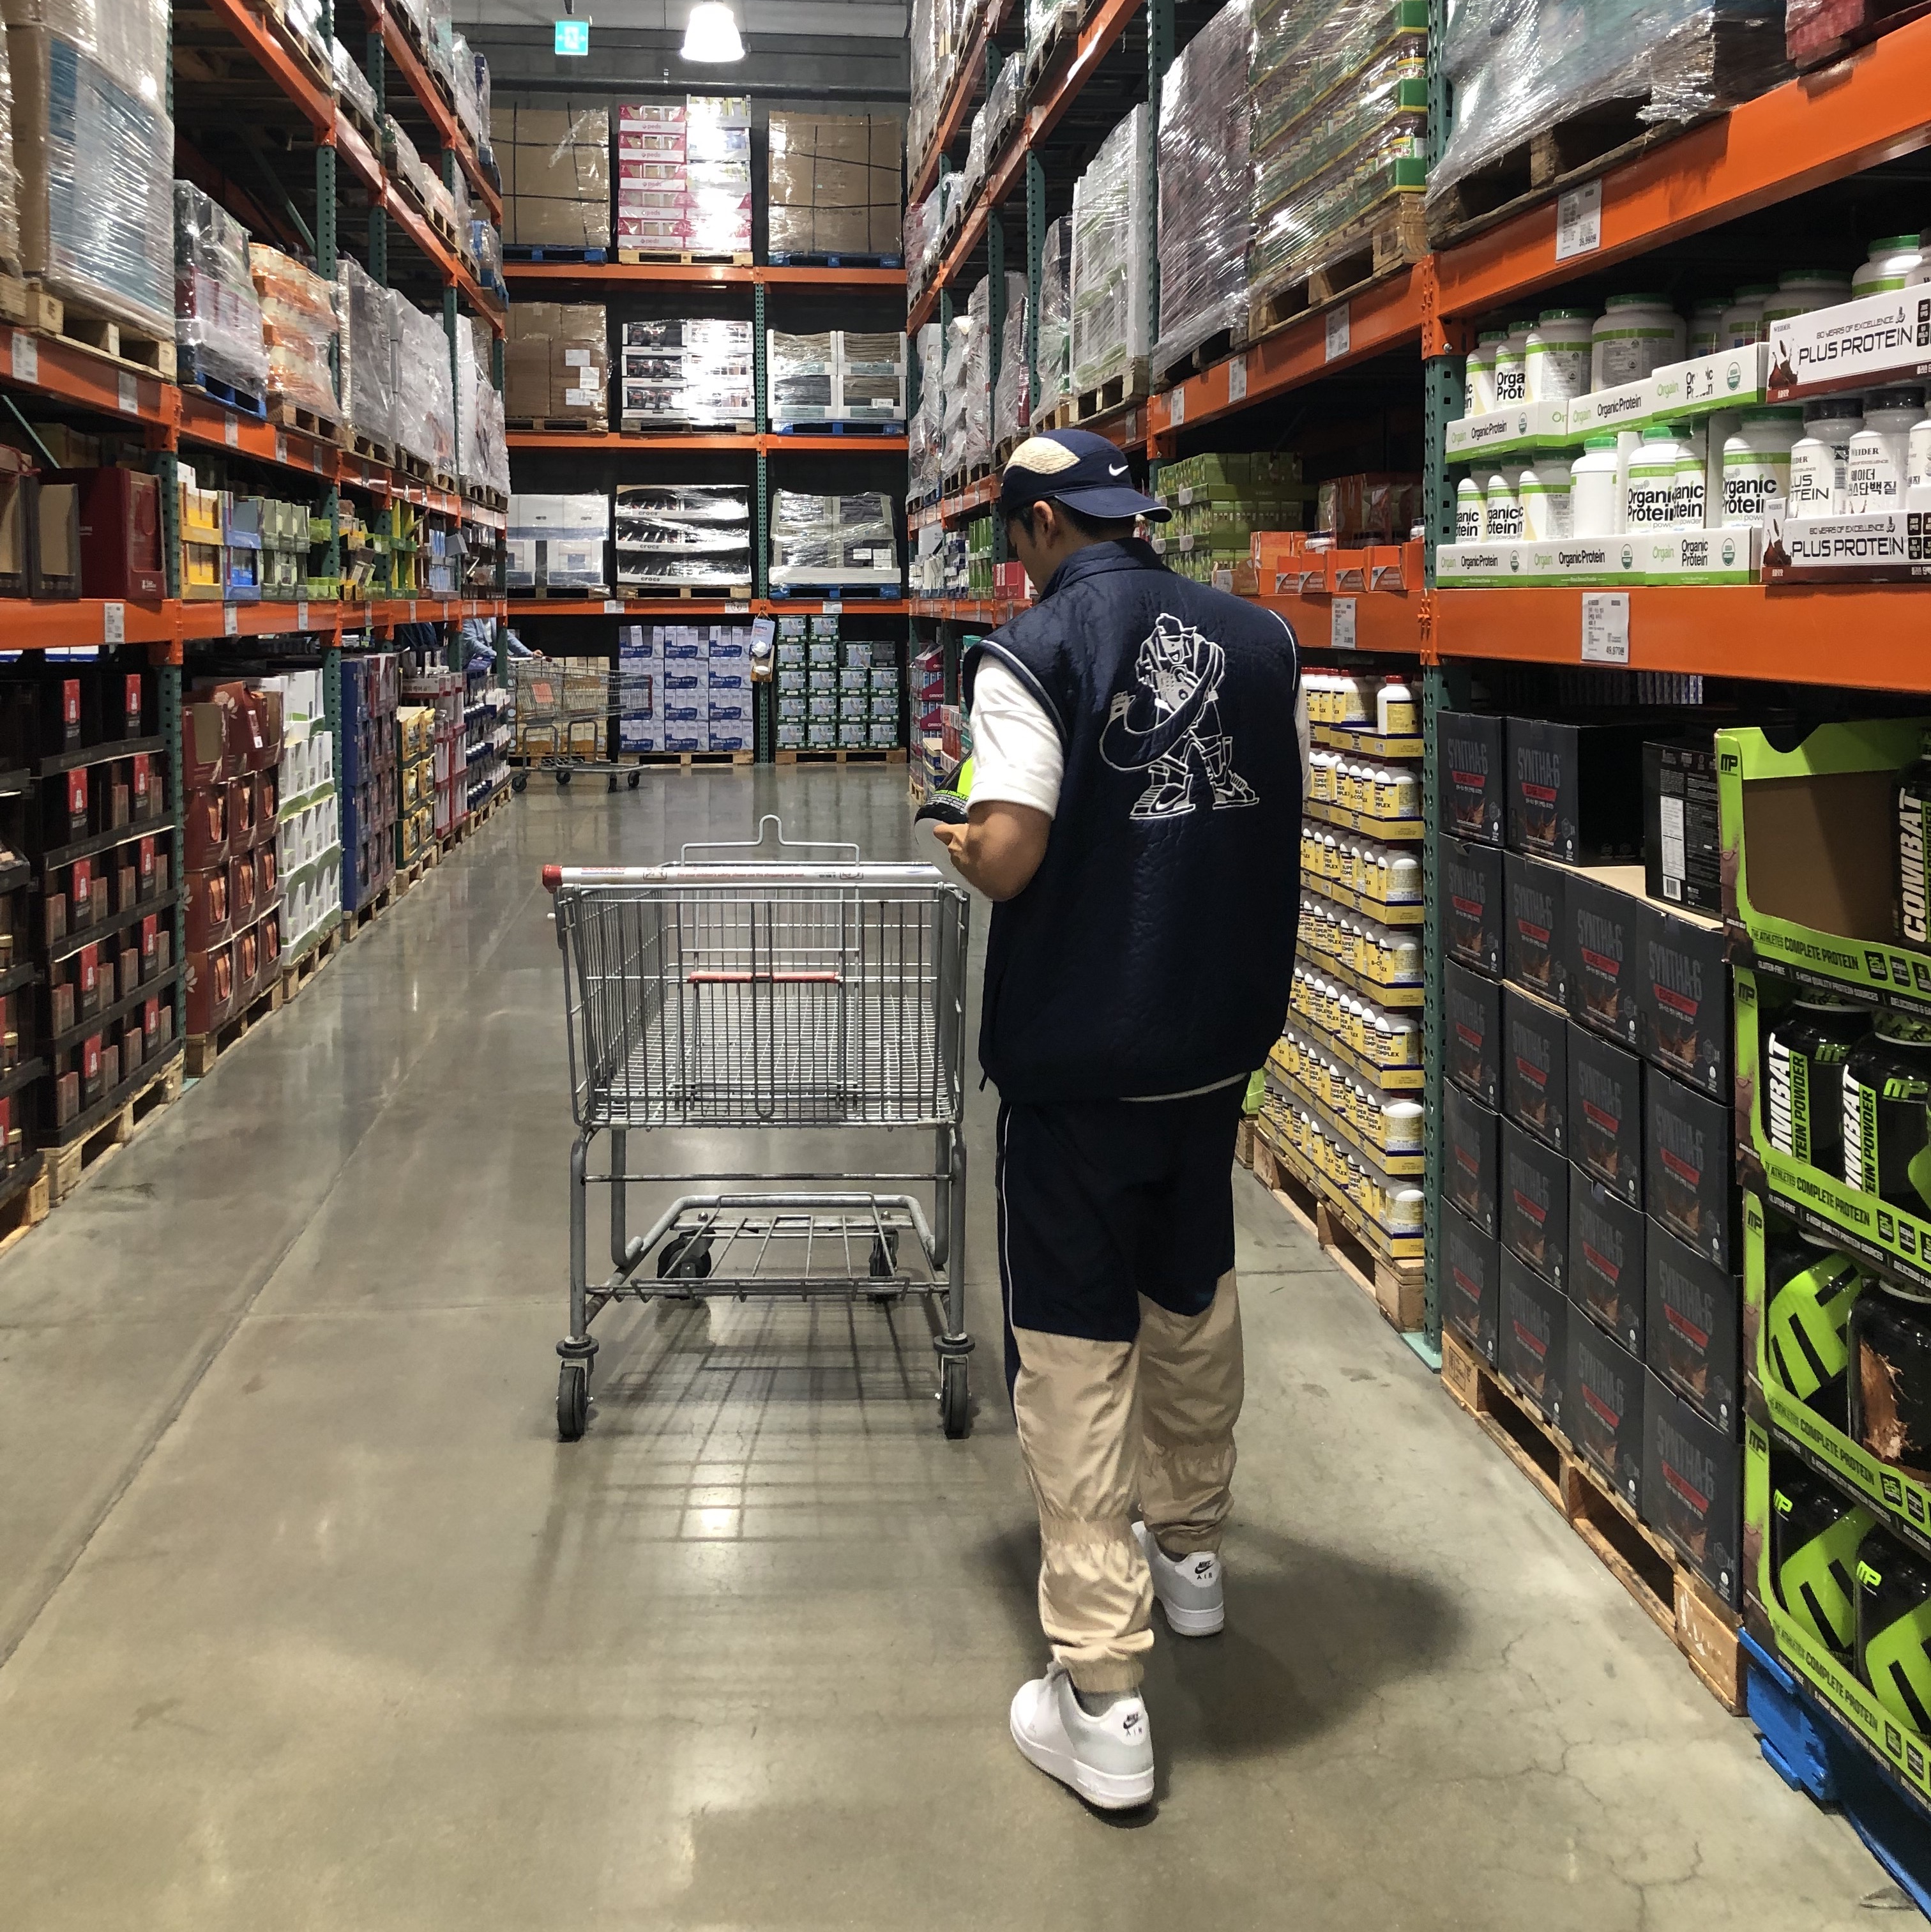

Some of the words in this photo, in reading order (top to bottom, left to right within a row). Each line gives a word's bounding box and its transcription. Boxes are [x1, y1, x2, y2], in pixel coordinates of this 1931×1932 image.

[1826, 326, 1845, 337] YEARS
[1854, 316, 1894, 331] EXCELLENCE
[1799, 338, 1838, 365] PLUS
[1841, 325, 1912, 357] PROTEIN
[1657, 382, 1679, 399] Orgain
[1598, 400, 1619, 418] Organic
[1619, 396, 1642, 411] Protein
[1471, 424, 1489, 441] Organic
[1488, 420, 1508, 436] Protein
[1845, 524, 1884, 533] EXCELLENCE
[1653, 546, 1675, 562] Orgain
[1681, 538, 1709, 555] Organic
[1792, 540, 1831, 558] PLUS
[1835, 536, 1904, 557] PROTEIN
[1461, 554, 1480, 569] Organic
[1480, 554, 1499, 567] Protein
[1534, 552, 1553, 569] Orgain
[1559, 550, 1582, 567] Organic
[1582, 549, 1606, 563] Protein
[1681, 551, 1709, 567] Protein
[1518, 747, 1560, 788] SYNTHA-6
[1898, 787, 1927, 943] COMBAT
[1785, 937, 1821, 960] COMPLETE
[1821, 948, 1859, 970] PROTEIN
[1792, 1054, 1808, 1122] POWDER
[1861, 1088, 1875, 1157] POWDER
[1797, 1177, 1835, 1208] COMPLETE
[1835, 1196, 1870, 1226] PROTEIN
[1800, 1419, 1840, 1459] COMPLETE
[1840, 1449, 1875, 1486] PROTEIN
[1805, 1651, 1845, 1700] COMPLETE
[1845, 1690, 1878, 1732] PROTEIN
